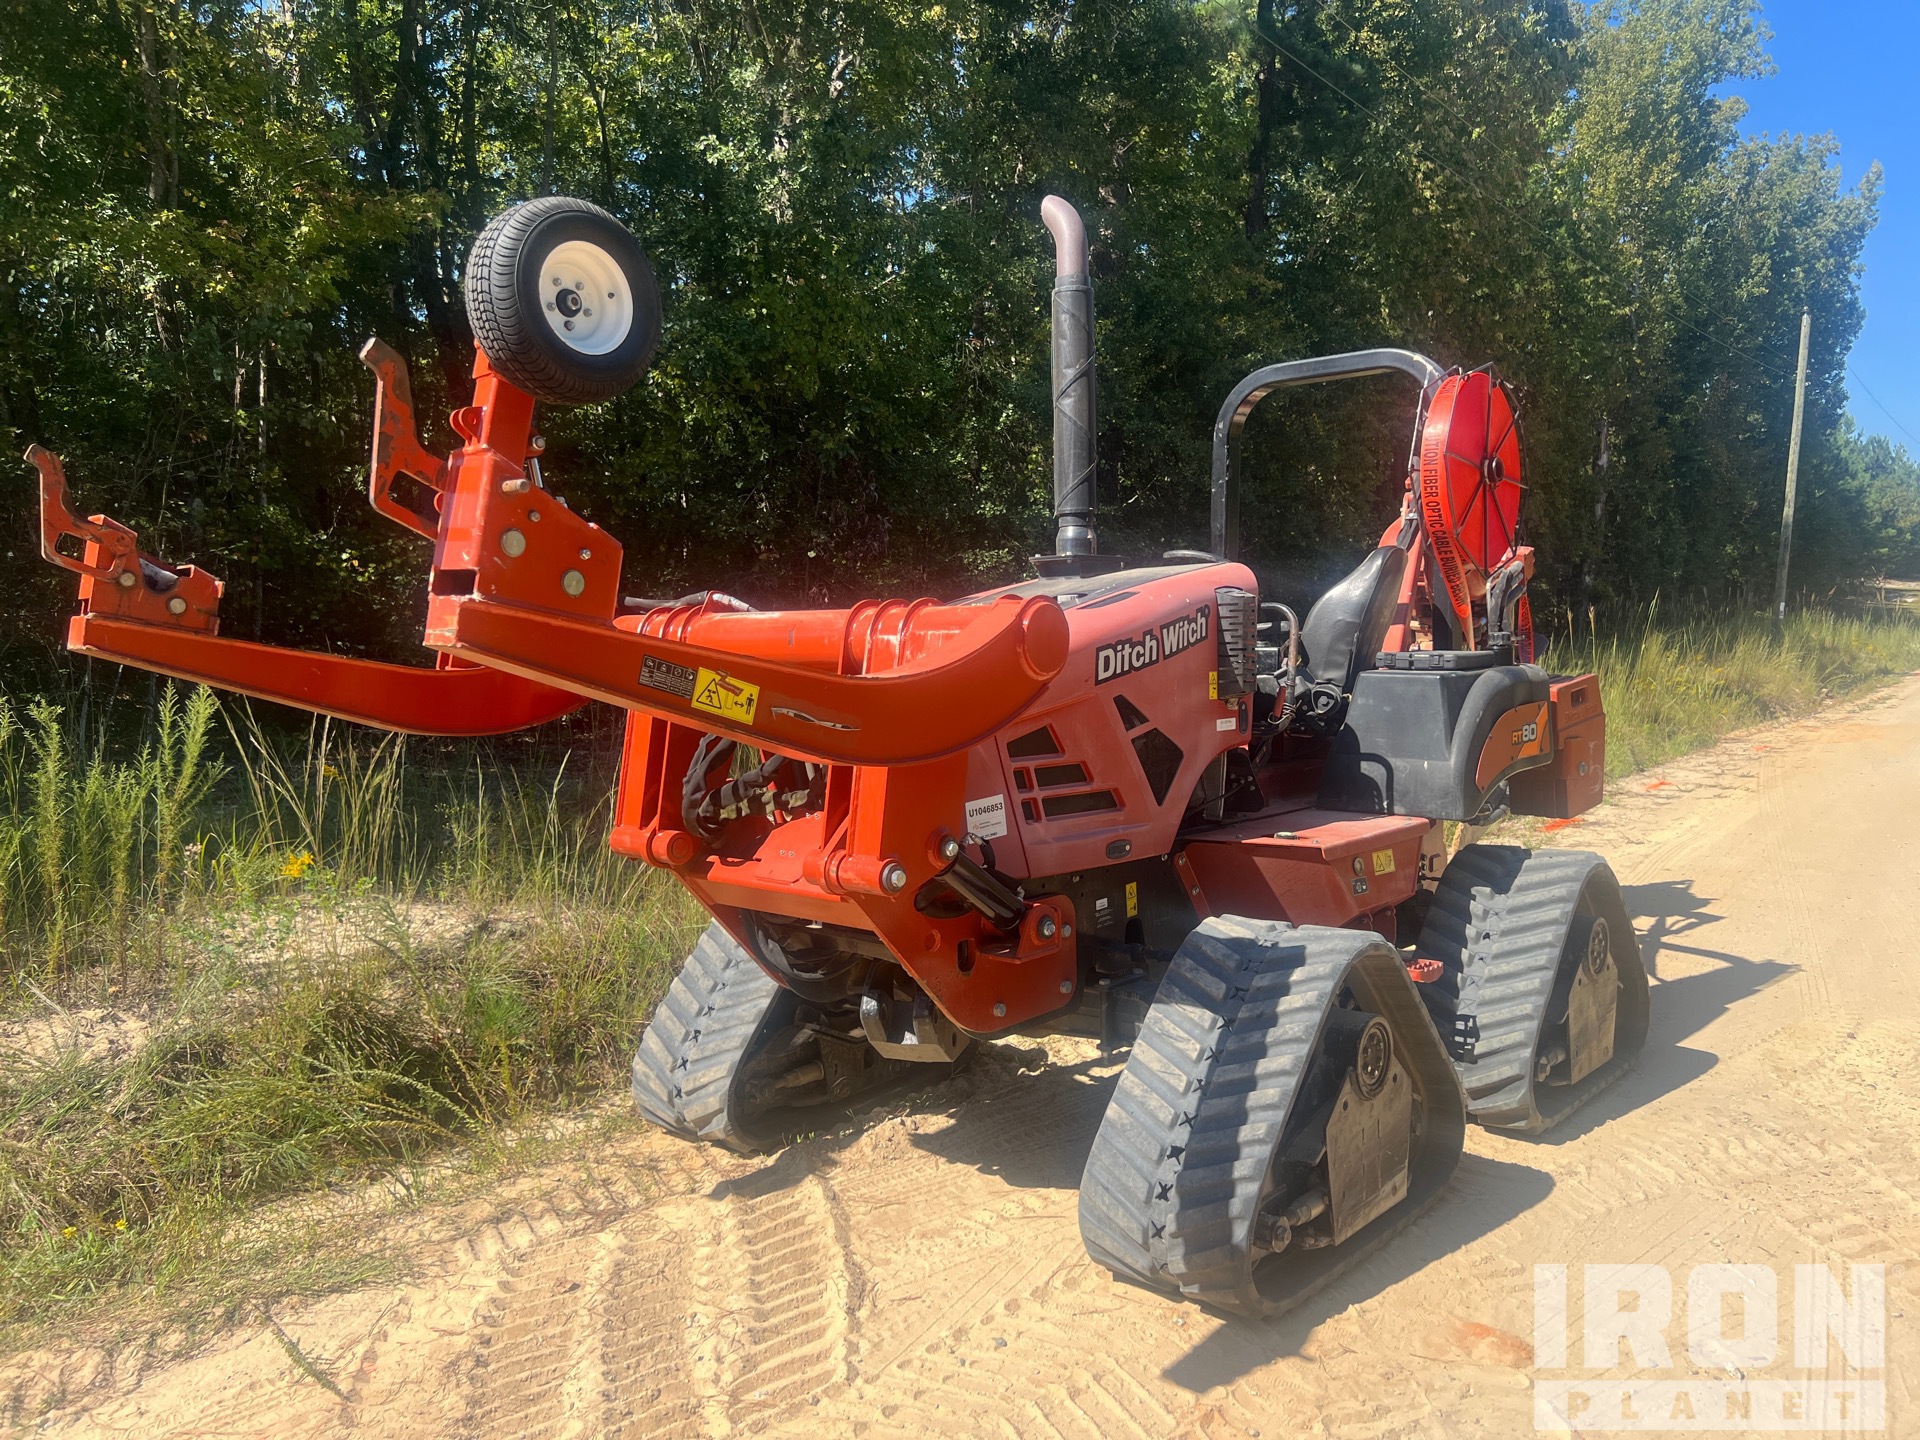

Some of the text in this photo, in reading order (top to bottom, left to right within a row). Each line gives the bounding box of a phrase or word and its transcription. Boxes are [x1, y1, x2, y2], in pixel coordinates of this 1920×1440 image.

[1423, 469, 1439, 498] FIBER
[1425, 500, 1444, 529] OPTIC
[1431, 529, 1454, 556] CABLE
[1440, 555, 1462, 584] BURIED
[1097, 612, 1206, 681] Ditch Witch
[1512, 723, 1537, 744] RT80
[968, 802, 1003, 818] U1046853
